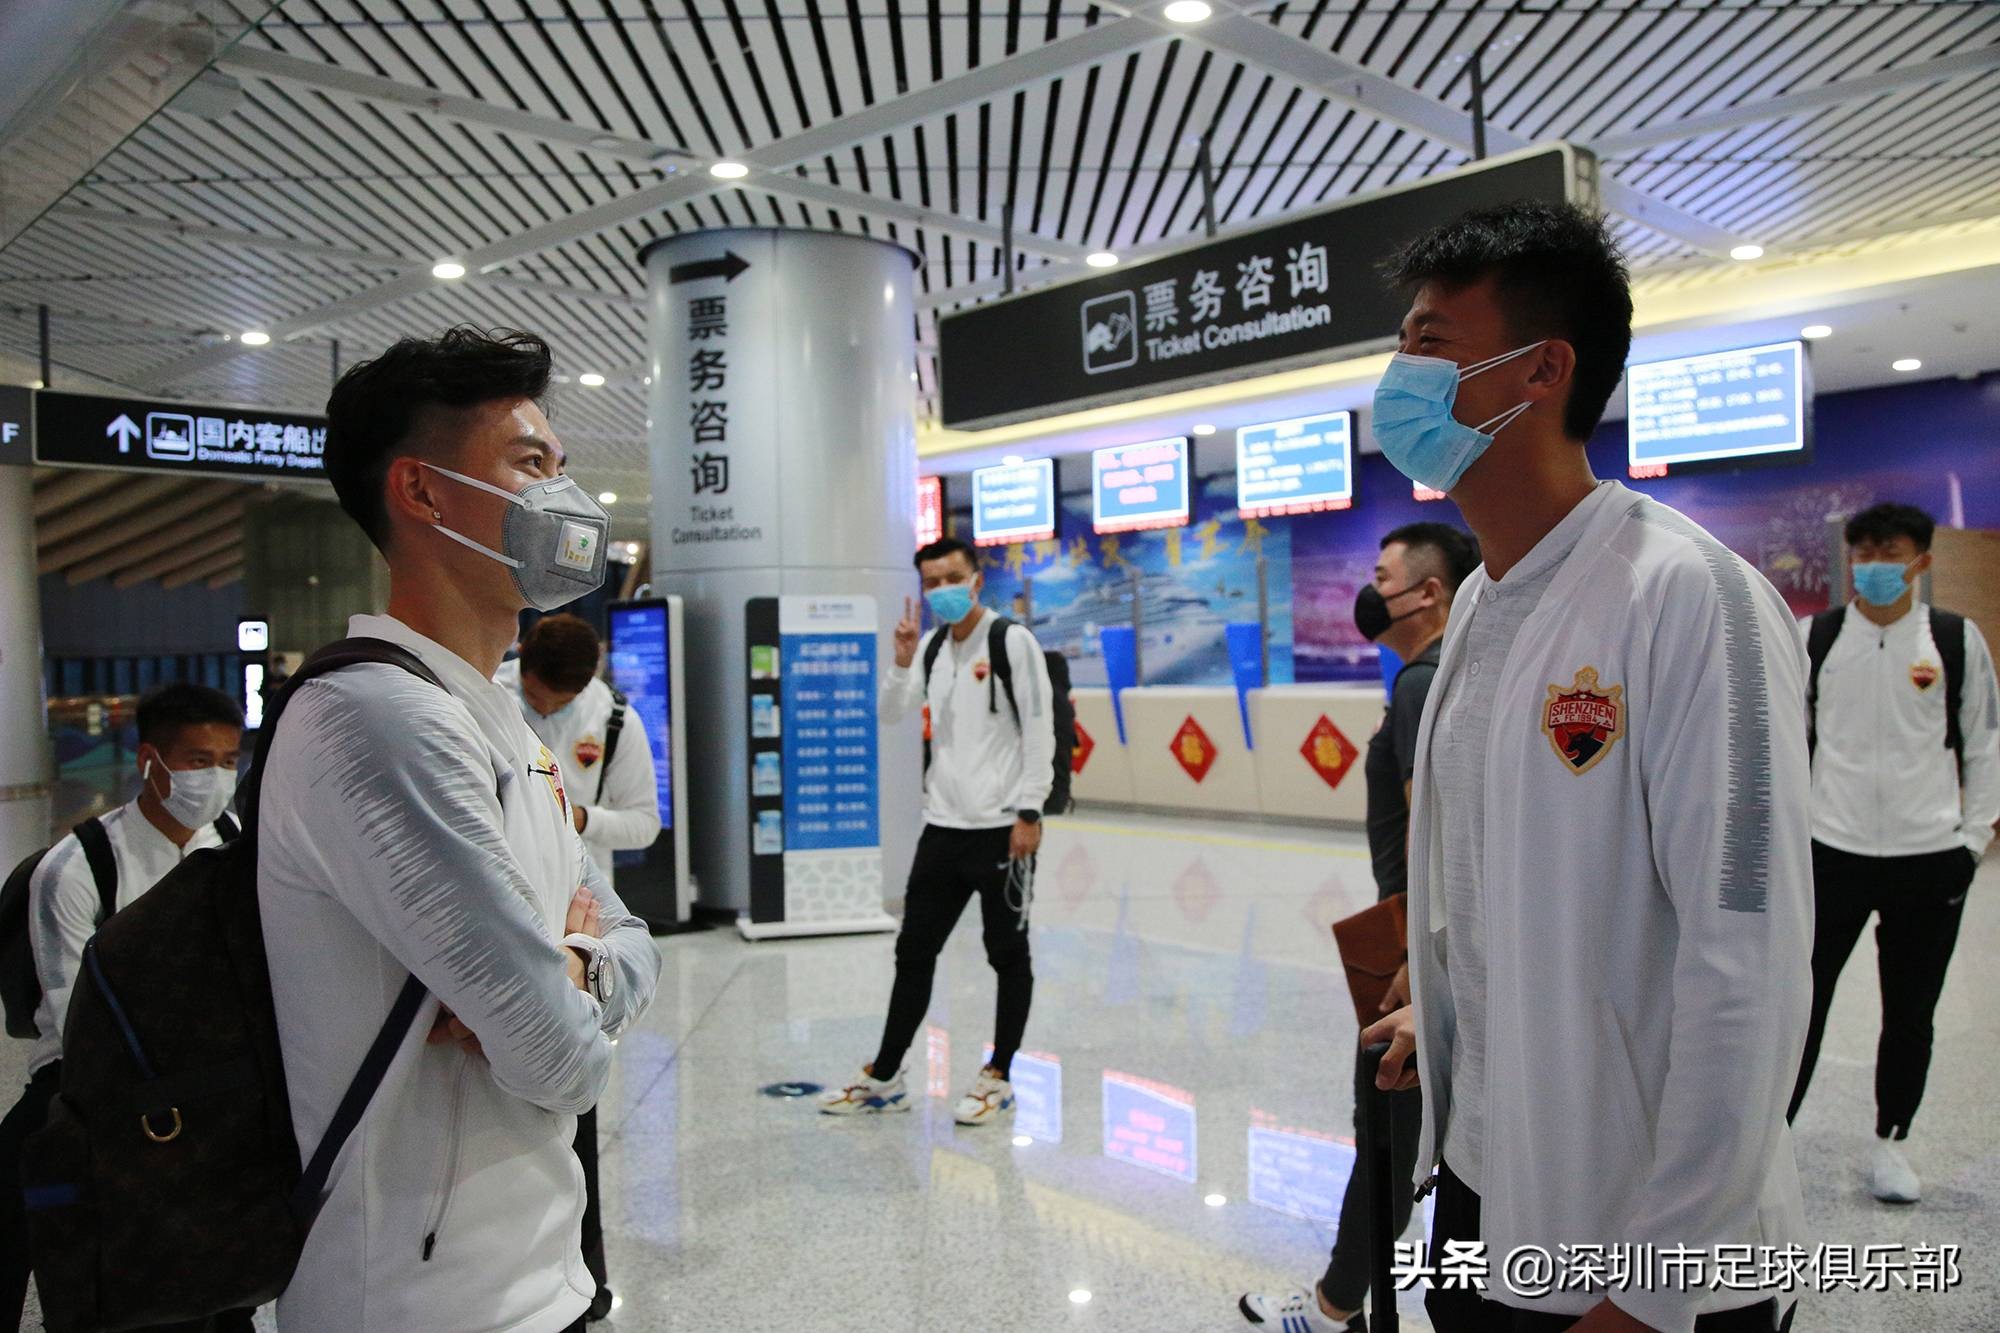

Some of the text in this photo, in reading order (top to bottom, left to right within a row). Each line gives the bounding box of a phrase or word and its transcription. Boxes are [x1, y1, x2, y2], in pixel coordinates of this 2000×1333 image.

[1142, 241, 1330, 332] 票务咨询
[1145, 303, 1332, 363] Ticket Consultation
[688, 296, 729, 495] 票务咨询
[1, 421, 20, 444] F
[689, 505, 734, 522] Ticket
[671, 527, 762, 545] Consultation
[1552, 702, 1613, 720] SHENZHEN
